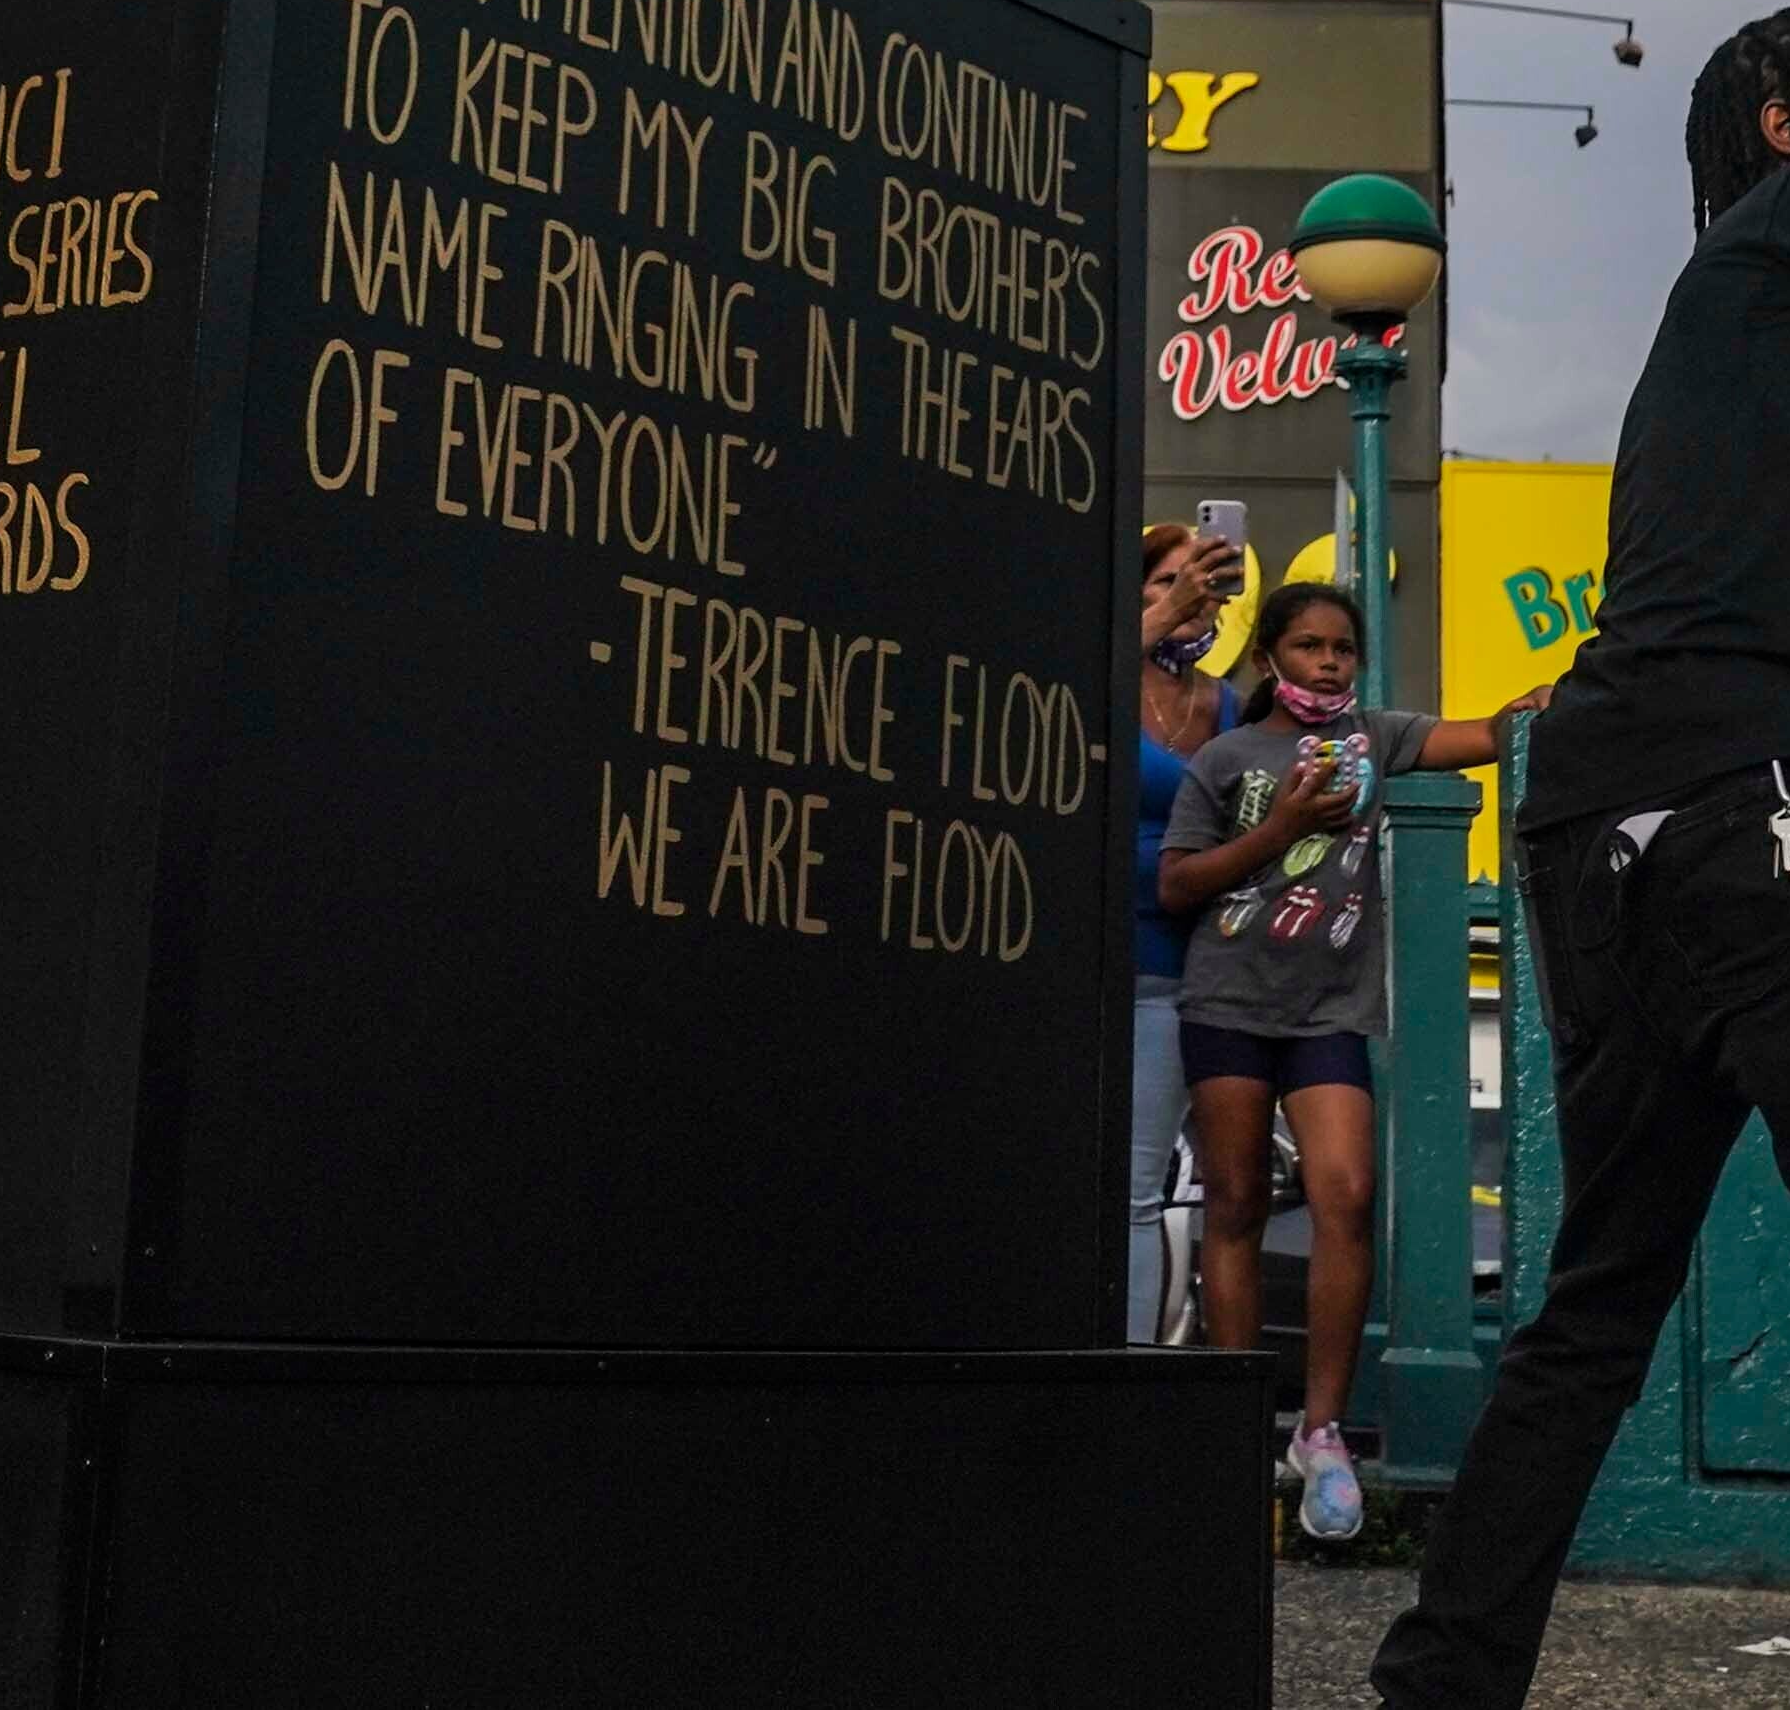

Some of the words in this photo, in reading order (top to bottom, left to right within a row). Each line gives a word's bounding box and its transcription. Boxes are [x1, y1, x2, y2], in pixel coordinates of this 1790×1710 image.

[450, 32, 597, 194] KEEP
[618, 88, 713, 232] MY
[742, 130, 836, 284] BIG
[877, 33, 1084, 223] CONTINUE
[1148, 70, 1260, 152] Y
[2, 189, 159, 318] SERIES
[1177, 225, 1312, 323] Re
[321, 161, 508, 349] NAME
[534, 219, 759, 413] RINGING
[804, 305, 856, 435] IN
[892, 327, 976, 478] THE
[986, 366, 1091, 512] EARS
[1158, 312, 1407, 421] Velv
[306, 338, 410, 497] OF
[598, 762, 690, 916] WE
[709, 786, 829, 934] ARE
[882, 809, 1030, 962] FLOYD
